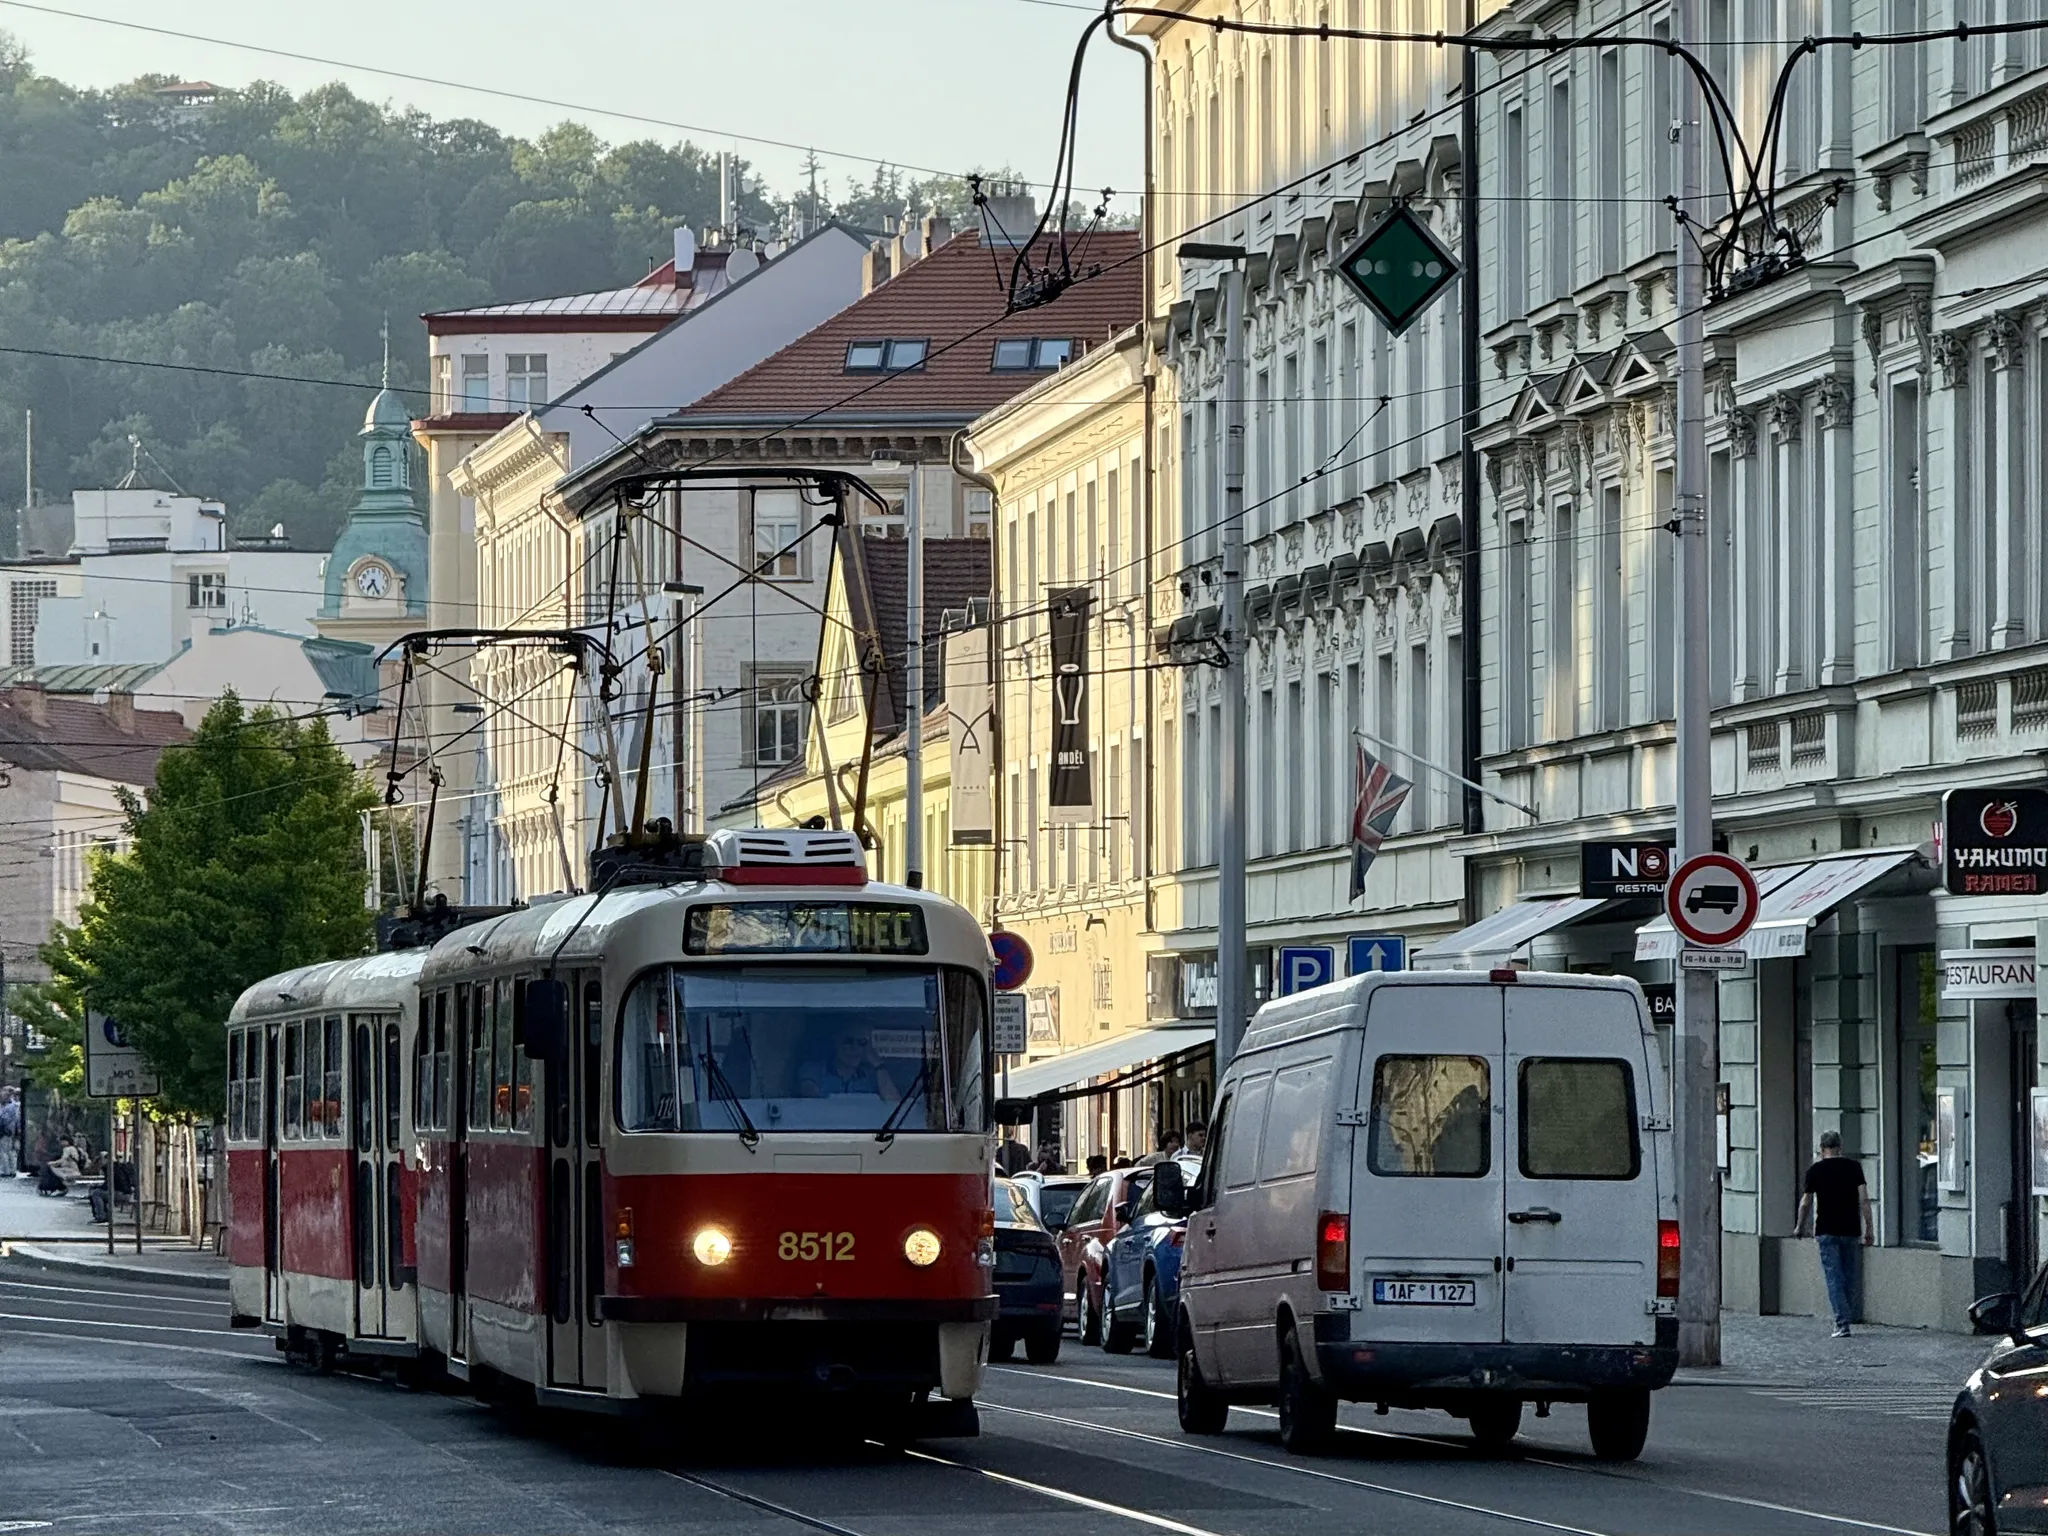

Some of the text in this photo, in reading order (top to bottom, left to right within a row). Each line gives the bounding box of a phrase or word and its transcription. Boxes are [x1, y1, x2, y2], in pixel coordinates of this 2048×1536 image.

[1954, 848, 2047, 868] YAKUMO
[1965, 874, 2037, 891] RAMEN
[778, 1231, 856, 1261] 8512
[1389, 1284, 1416, 1300] 1AF
